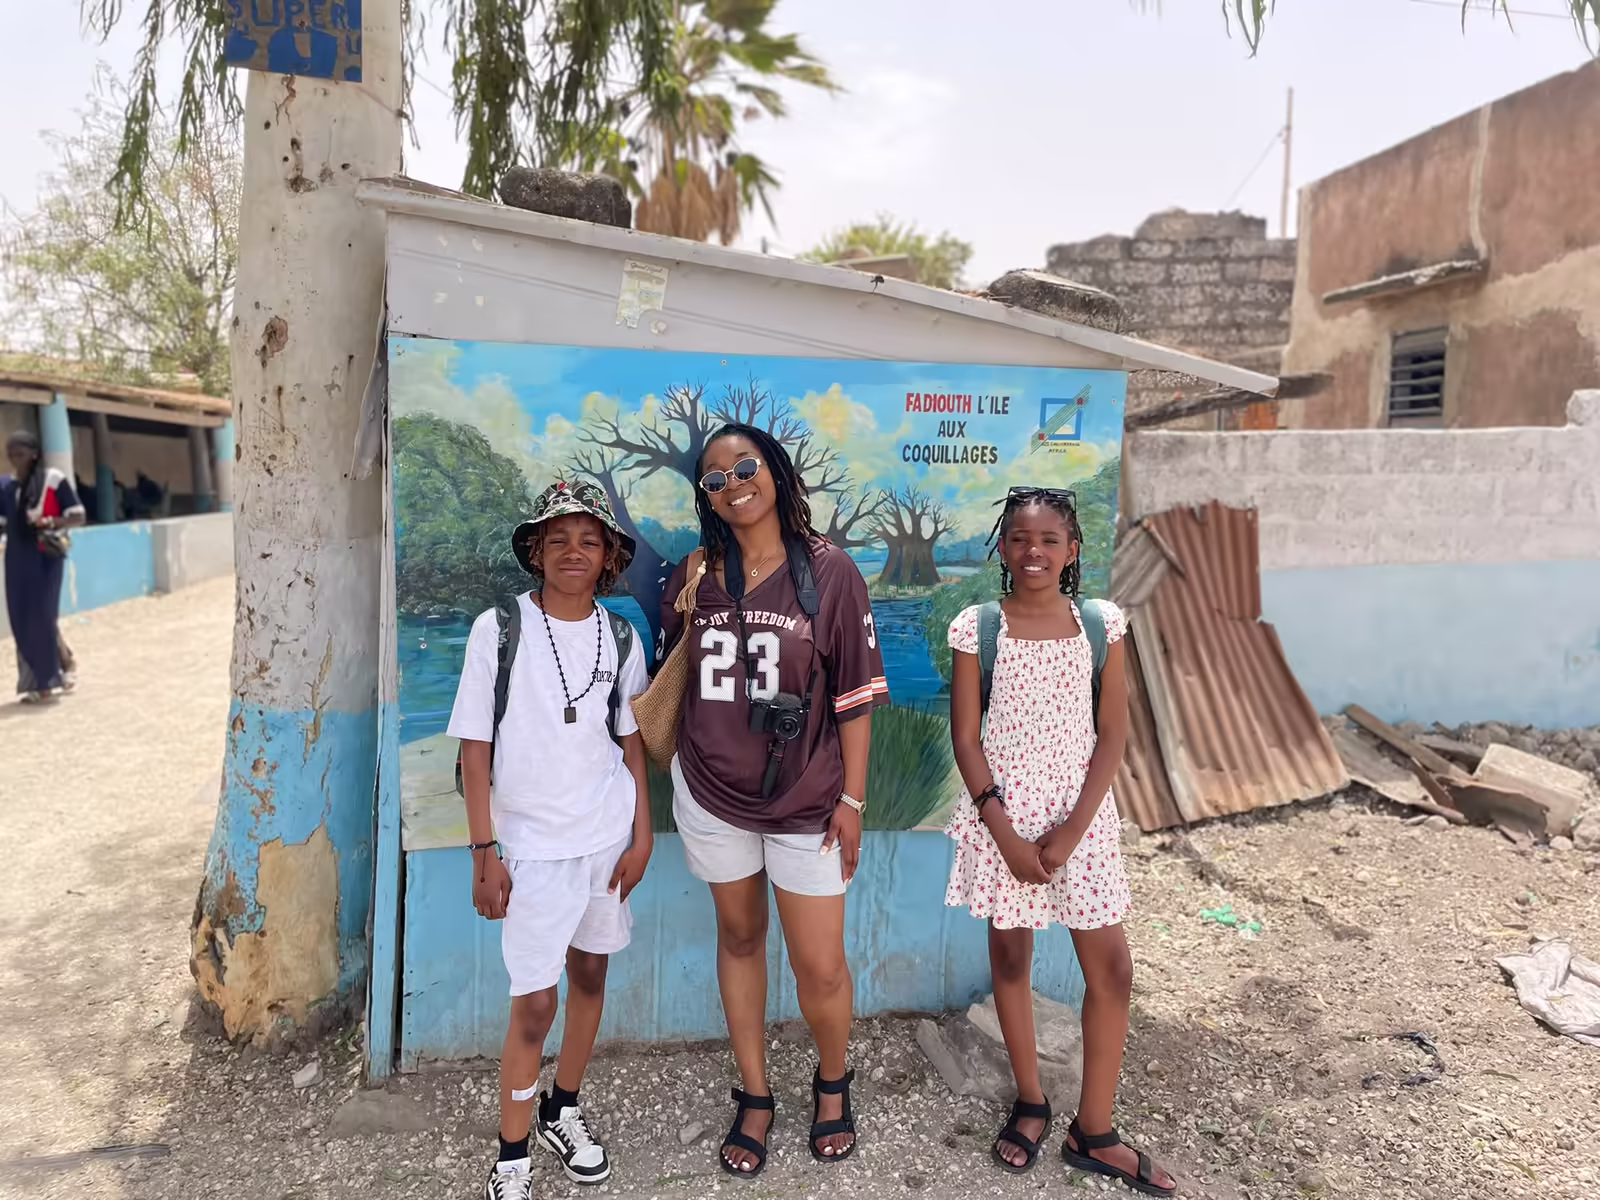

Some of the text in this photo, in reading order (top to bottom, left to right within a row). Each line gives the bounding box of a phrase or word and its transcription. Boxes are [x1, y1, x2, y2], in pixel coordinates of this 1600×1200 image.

[905, 392, 972, 414] FADIOUTH
[937, 420, 967, 439] AUX
[902, 444, 999, 465] COQUILLAGES
[700, 627, 780, 702] 23
